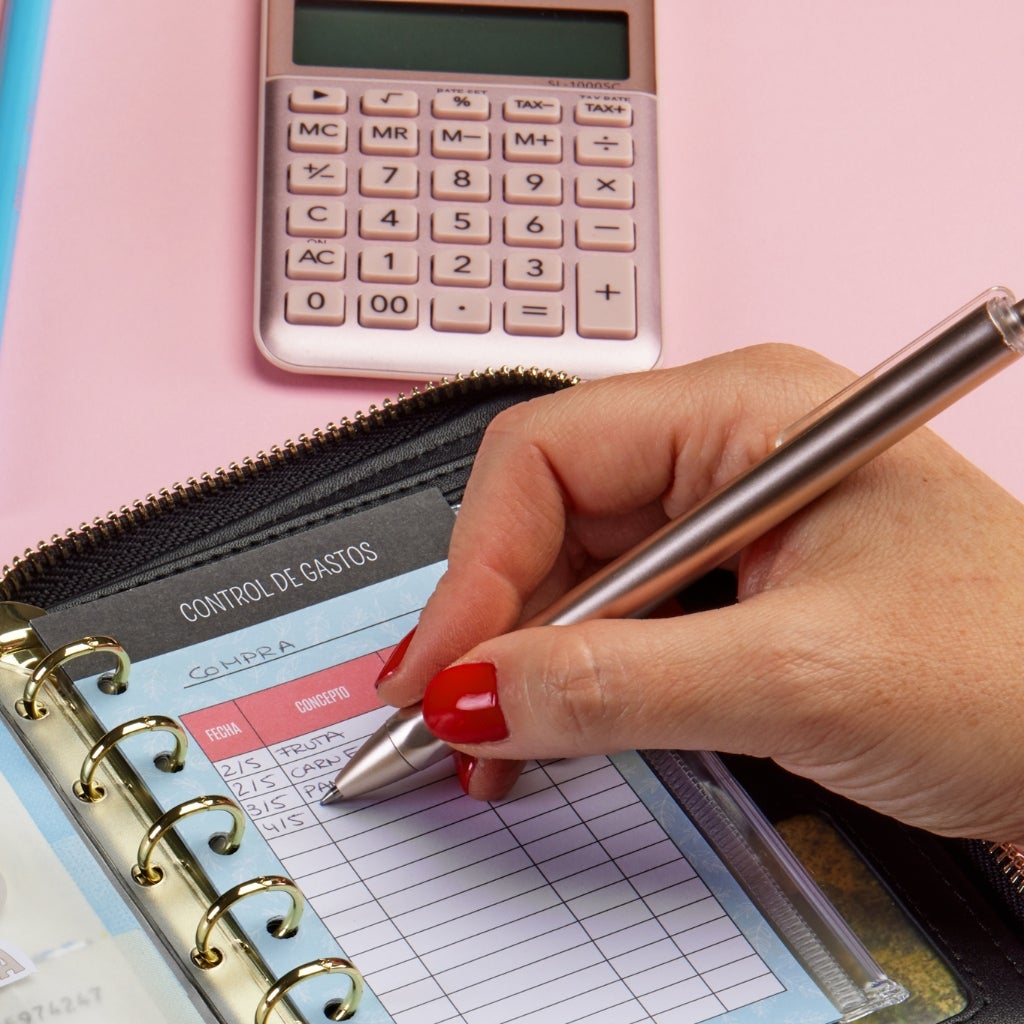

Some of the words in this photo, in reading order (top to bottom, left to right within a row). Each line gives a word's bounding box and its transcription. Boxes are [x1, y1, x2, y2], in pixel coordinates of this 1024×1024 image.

[585, 103, 626, 114] TAX+
[299, 123, 339, 137] MC
[372, 126, 408, 140] MR
[514, 132, 554, 147] M+
[381, 166, 399, 184] 7
[453, 170, 471, 188] 8
[525, 173, 544, 191] 9
[307, 205, 328, 222] C
[380, 208, 400, 227] 4
[453, 212, 471, 231] 5
[526, 215, 544, 234] 6
[298, 248, 335, 265] AC
[384, 252, 395, 270] 1
[453, 255, 471, 273] 2
[526, 259, 544, 277] 3
[307, 291, 326, 310] 0
[370, 295, 409, 314] 00
[179, 578, 274, 623] CONTROL
[270, 567, 304, 593] DE
[299, 541, 378, 582] GASTOS
[188, 639, 296, 680] COMPRA
[294, 685, 351, 714] CONCEPTO
[204, 721, 242, 742] FECHA
[276, 731, 345, 757] FRUTA
